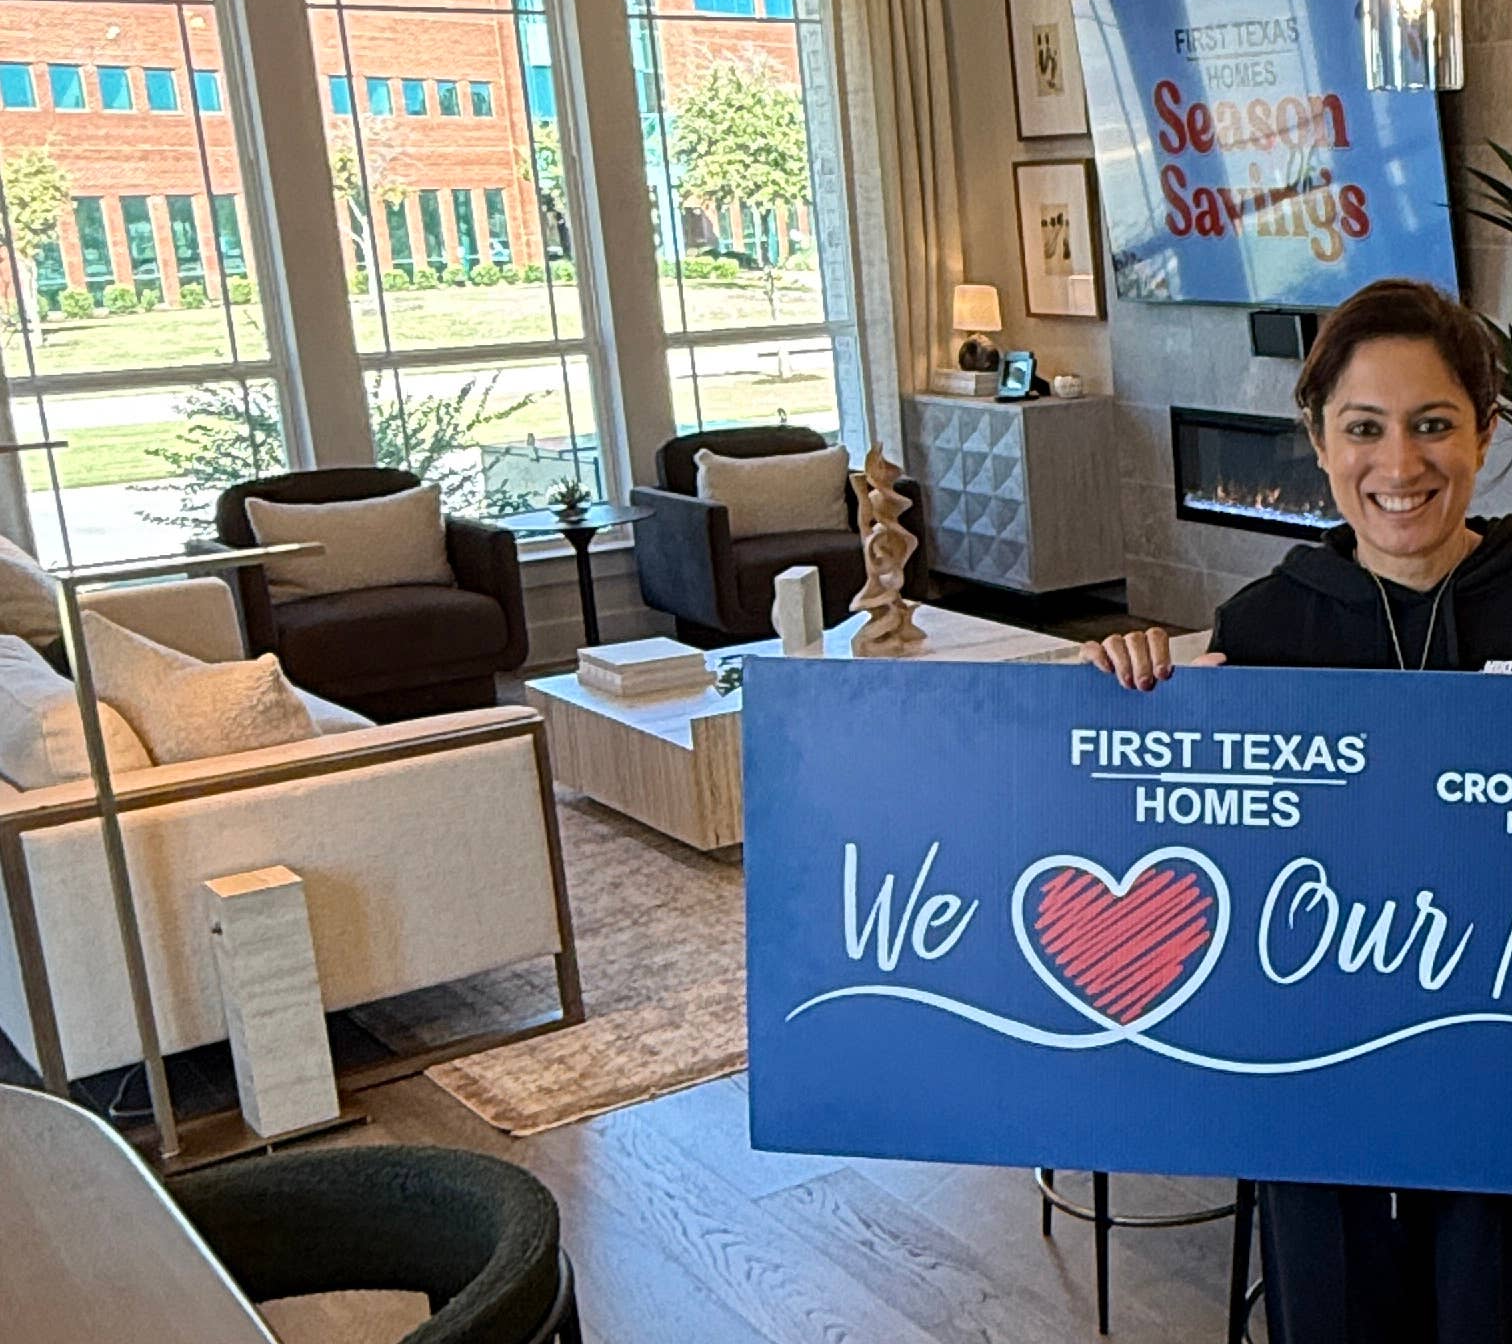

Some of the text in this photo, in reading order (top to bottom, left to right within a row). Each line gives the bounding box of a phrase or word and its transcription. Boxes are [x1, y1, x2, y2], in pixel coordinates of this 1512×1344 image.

[1174, 17, 1300, 54] FIRST TEXAS
[1206, 61, 1277, 90] HOMES
[1154, 80, 1350, 155] Season
[1160, 163, 1371, 263] Savings
[1070, 728, 1367, 774] FIRST TEXAS
[1135, 786, 1301, 828] HOMES
[843, 841, 979, 972] We
[1258, 856, 1473, 992] Our
